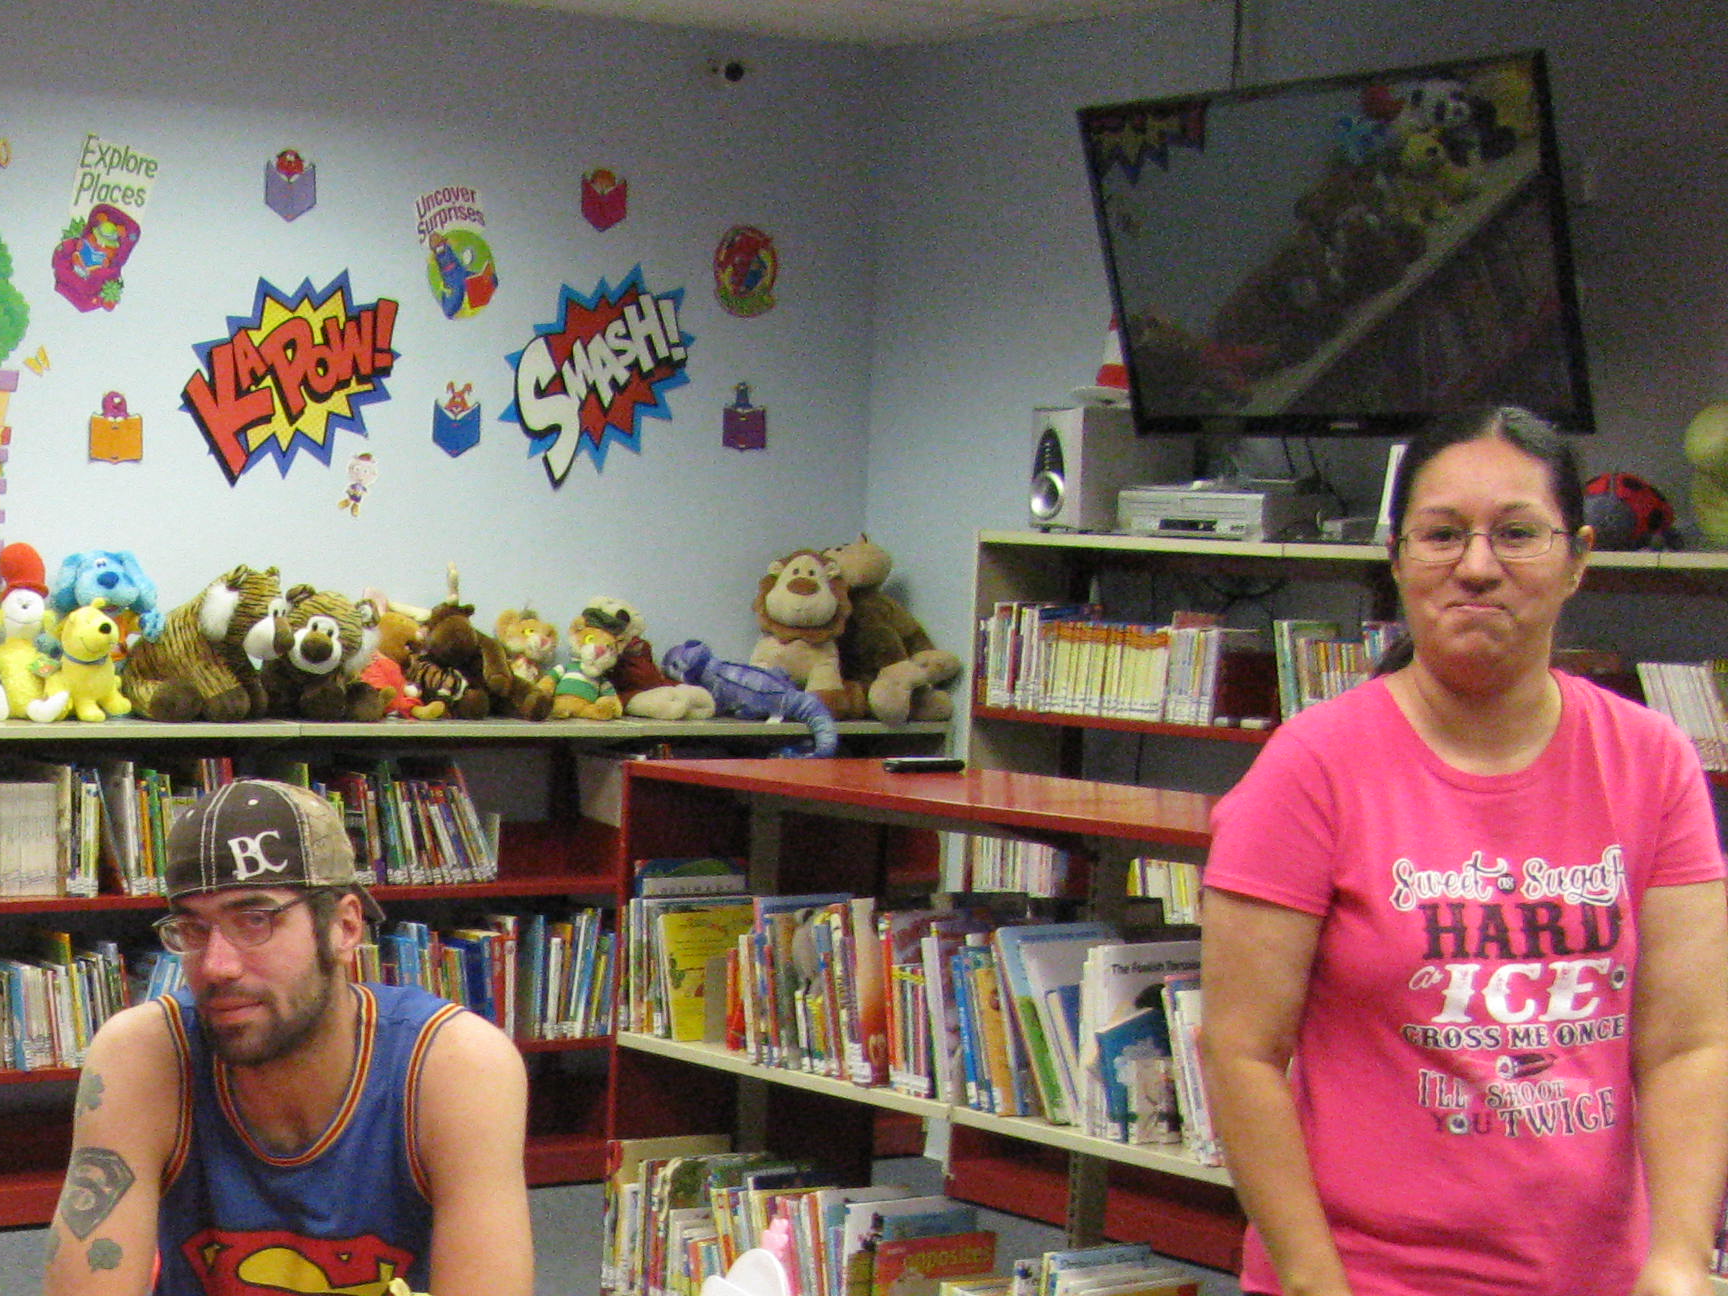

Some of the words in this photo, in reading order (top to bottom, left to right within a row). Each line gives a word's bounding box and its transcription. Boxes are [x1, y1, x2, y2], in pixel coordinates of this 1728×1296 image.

[80, 134, 158, 179] Explore
[74, 170, 147, 207] Places
[416, 186, 477, 219] Uncover
[417, 205, 485, 243] Surprises
[181, 297, 399, 487] KAPOW!
[515, 293, 687, 490] SMASH!
[227, 830, 289, 881] BC
[1389, 850, 1508, 912] Sweet
[1419, 901, 1624, 960] HARD
[1430, 958, 1612, 1024] ICE
[1400, 1023, 1505, 1050] CROSS
[1508, 1023, 1552, 1050] ME
[1555, 1014, 1626, 1049] ONCE
[1418, 1068, 1469, 1110] I'LL
[1485, 1080, 1566, 1110] SHOOT
[1498, 1087, 1617, 1138] TWICE
